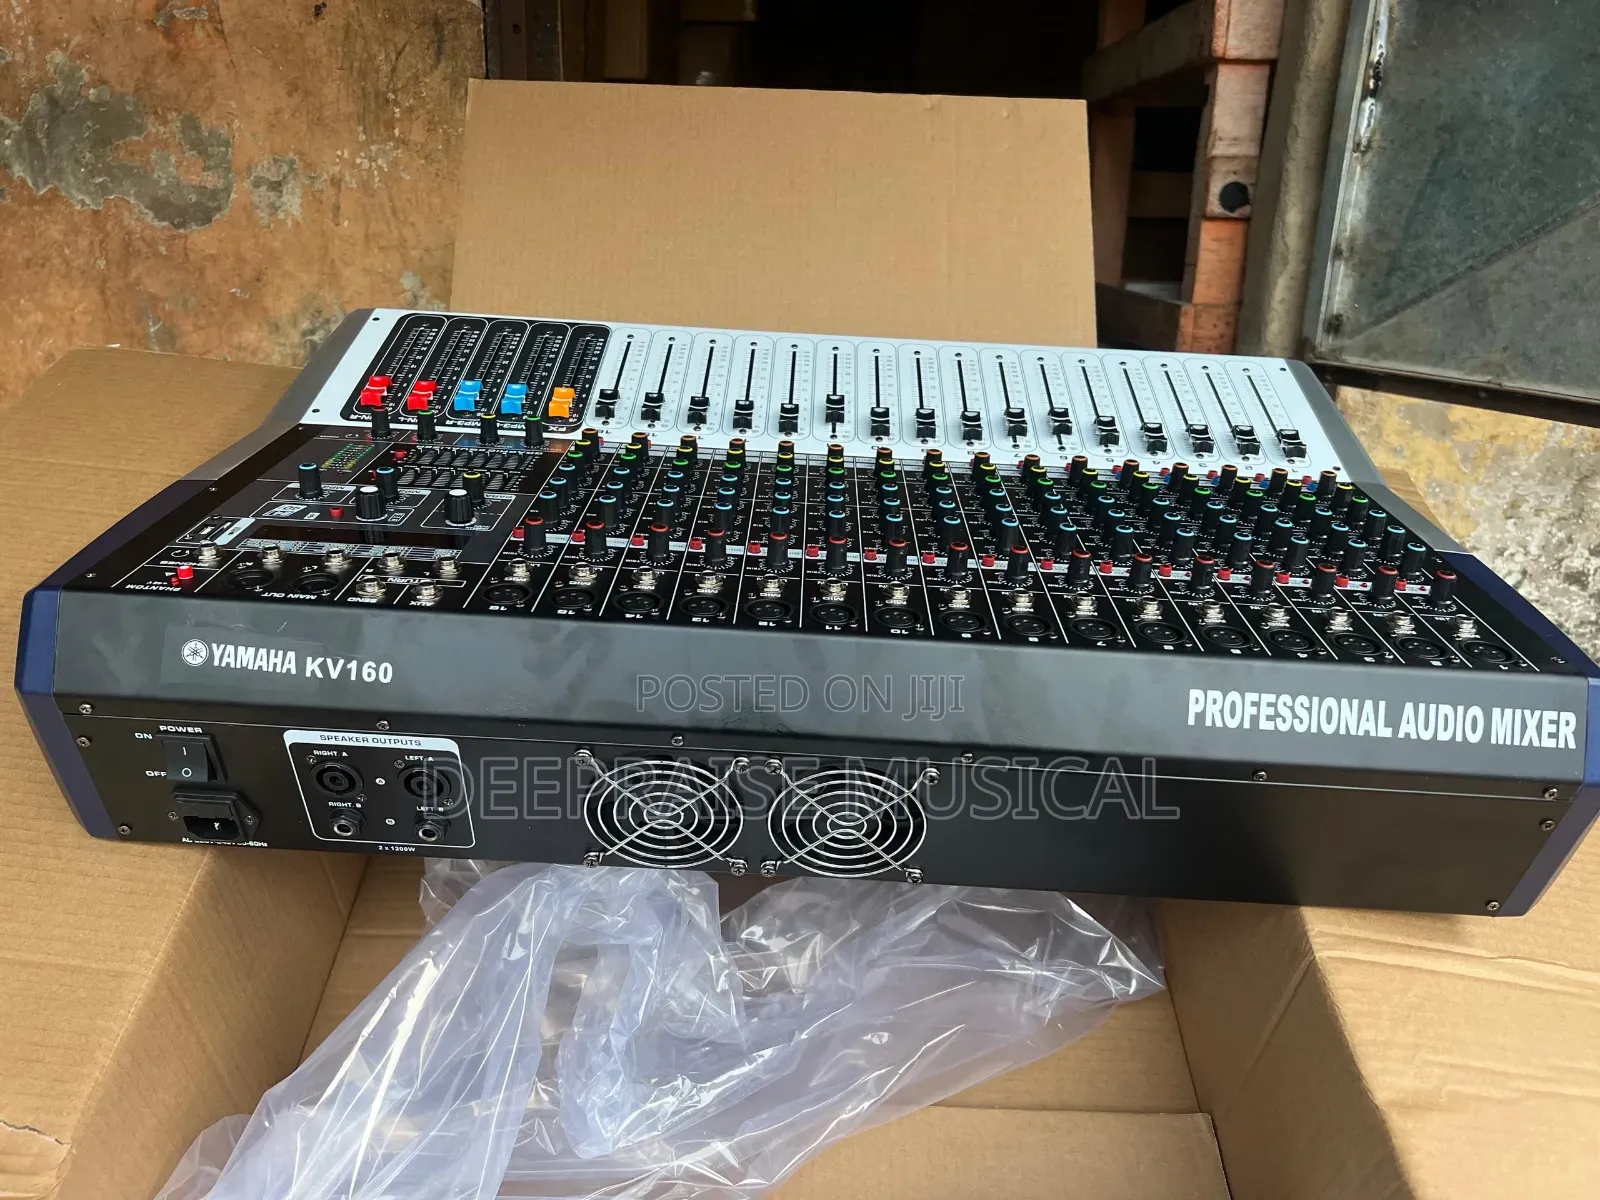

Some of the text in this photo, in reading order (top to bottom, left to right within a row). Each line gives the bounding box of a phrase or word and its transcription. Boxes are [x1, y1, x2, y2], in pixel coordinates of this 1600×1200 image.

[125, 584, 181, 592] PHANTOM
[286, 592, 317, 600] MAIN
[211, 642, 393, 684] YAMAHA KV160
[1188, 688, 1577, 750] PROFESSIONAL AUDIO MIXER
[159, 725, 203, 734] POWER
[134, 732, 153, 740] ON
[319, 734, 422, 746] SPEAKER OUTPUTS
[145, 770, 168, 778] OFF
